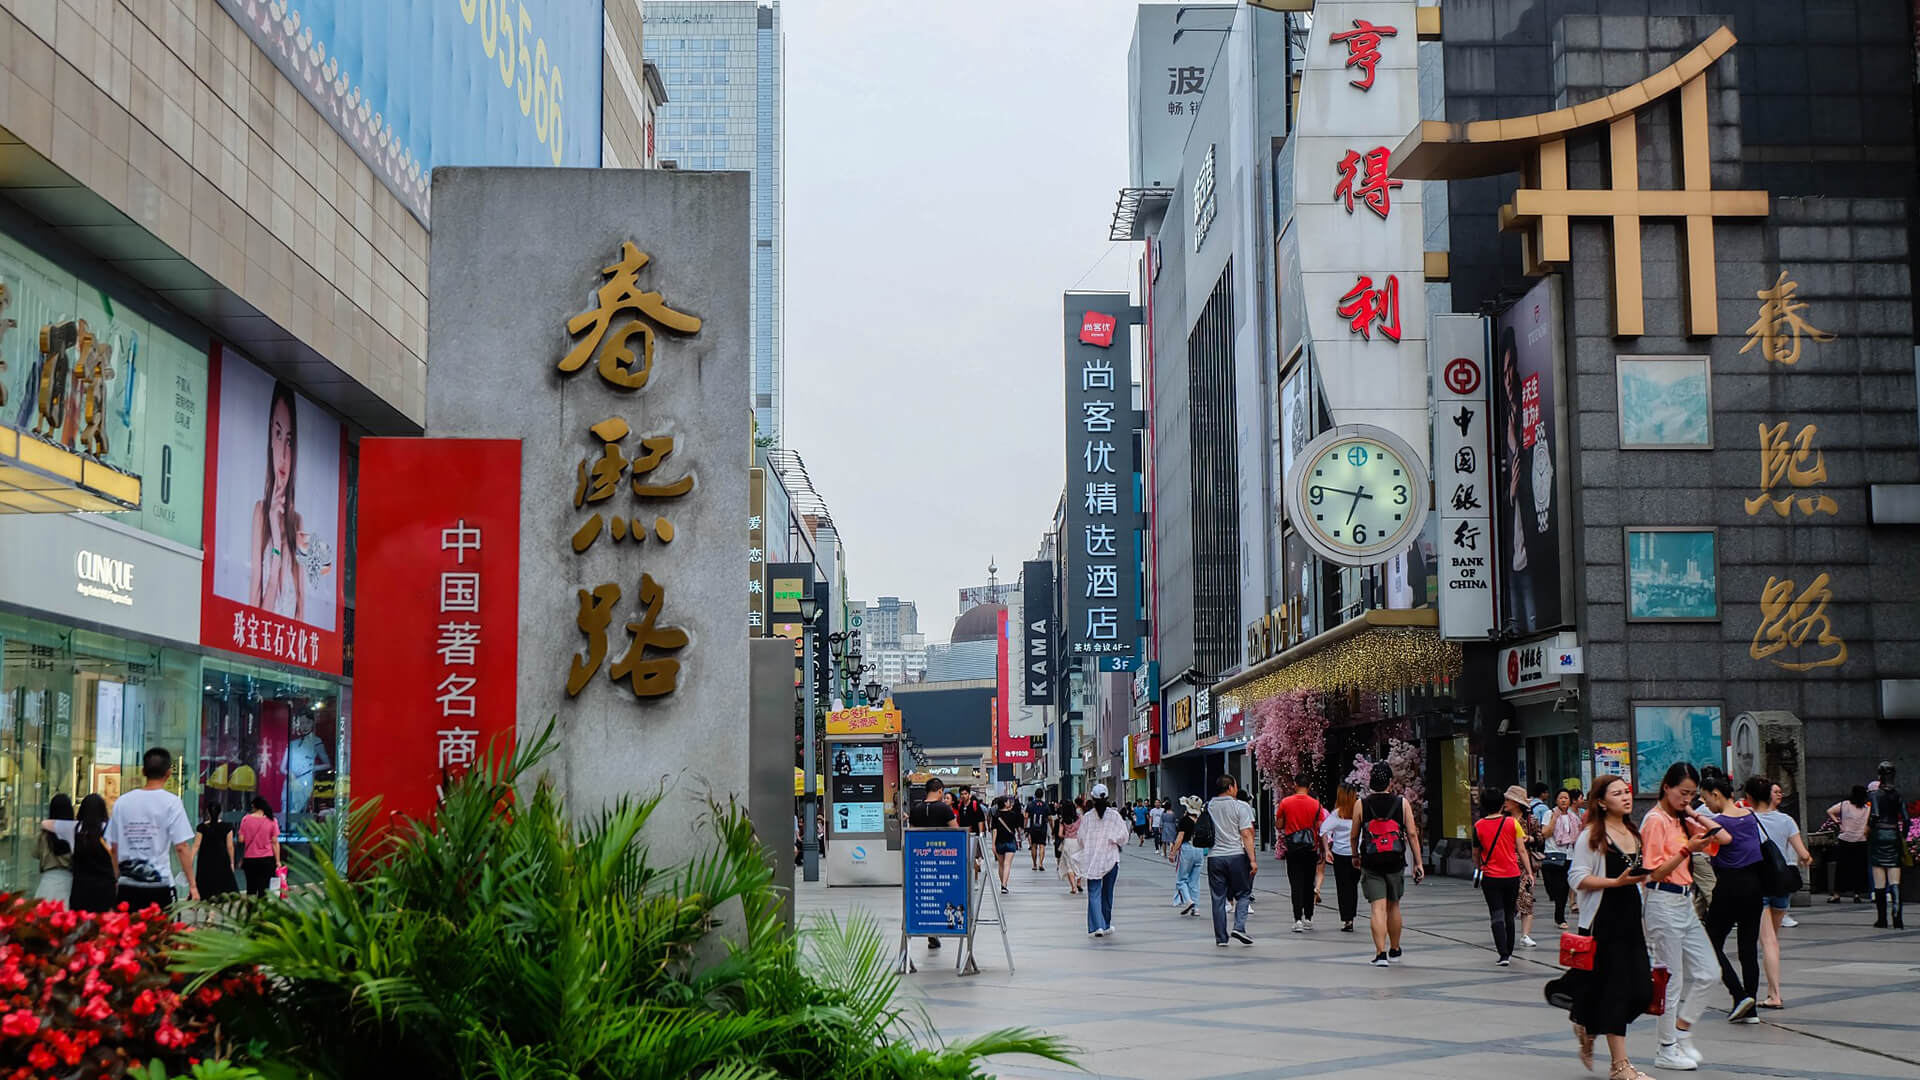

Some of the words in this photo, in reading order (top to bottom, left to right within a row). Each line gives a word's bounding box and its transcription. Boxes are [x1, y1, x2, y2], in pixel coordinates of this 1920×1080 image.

[1167, 66, 1205, 95] 波
[1329, 19, 1404, 344] 亨得利
[1084, 322, 1111, 332] 尚客优
[558, 241, 702, 697] 春熙路
[1738, 269, 1848, 672] 春熙路
[1082, 358, 1118, 640] 尚客优精选酒店
[1309, 485, 1324, 506] 9
[1392, 485, 1408, 505] 3
[1352, 524, 1367, 545] 6
[77, 550, 135, 592] CLINIQUE
[748, 515, 763, 626] 爱恋珠宝
[1451, 557, 1484, 567] BANK
[1460, 568, 1476, 578] OF
[1449, 579, 1488, 590] CHINA
[232, 609, 320, 666] 珠宝玉石文化节
[1074, 642, 1092, 652] 茶坊
[1093, 642, 1111, 652] 会议
[1112, 643, 1123, 652] 4F
[436, 519, 482, 804] 中国著名商
[1031, 619, 1048, 696] KAMA
[1111, 657, 1129, 671] 3F
